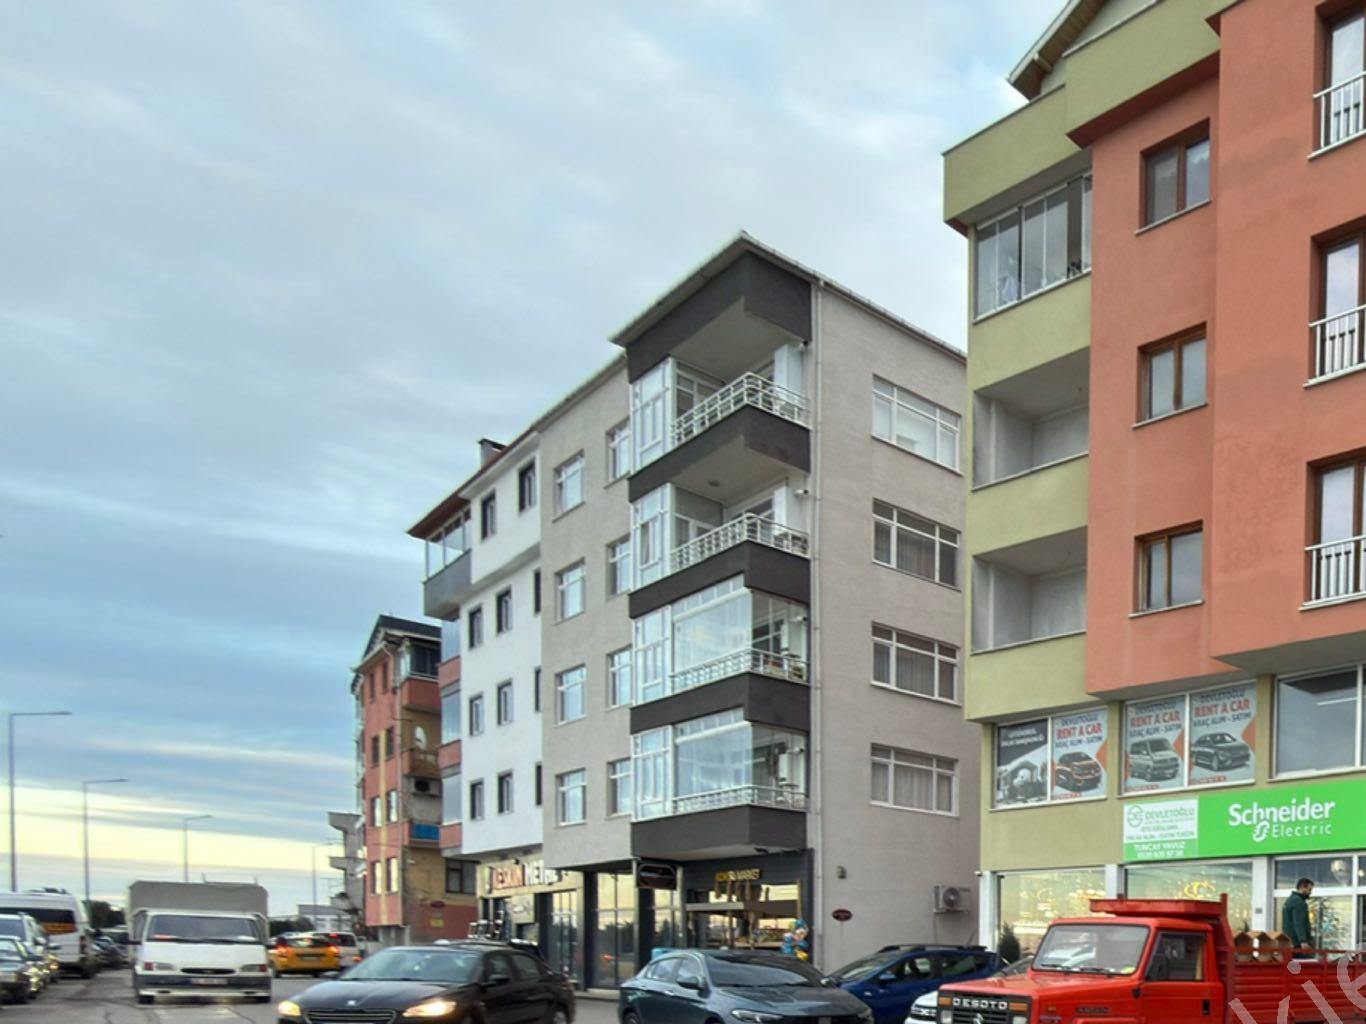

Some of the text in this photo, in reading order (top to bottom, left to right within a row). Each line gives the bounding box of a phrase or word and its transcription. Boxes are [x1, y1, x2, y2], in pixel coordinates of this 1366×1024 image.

[1194, 699, 1250, 717] RENT A CAR
[1130, 710, 1180, 728] RENT A CAR
[1056, 727, 1076, 740] RENT
[1078, 726, 1085, 736] A
[1086, 723, 1102, 735] CAR
[1229, 797, 1336, 826] Schneider
[1271, 823, 1332, 838] Electric
[953, 997, 1008, 1010] DESOTO
